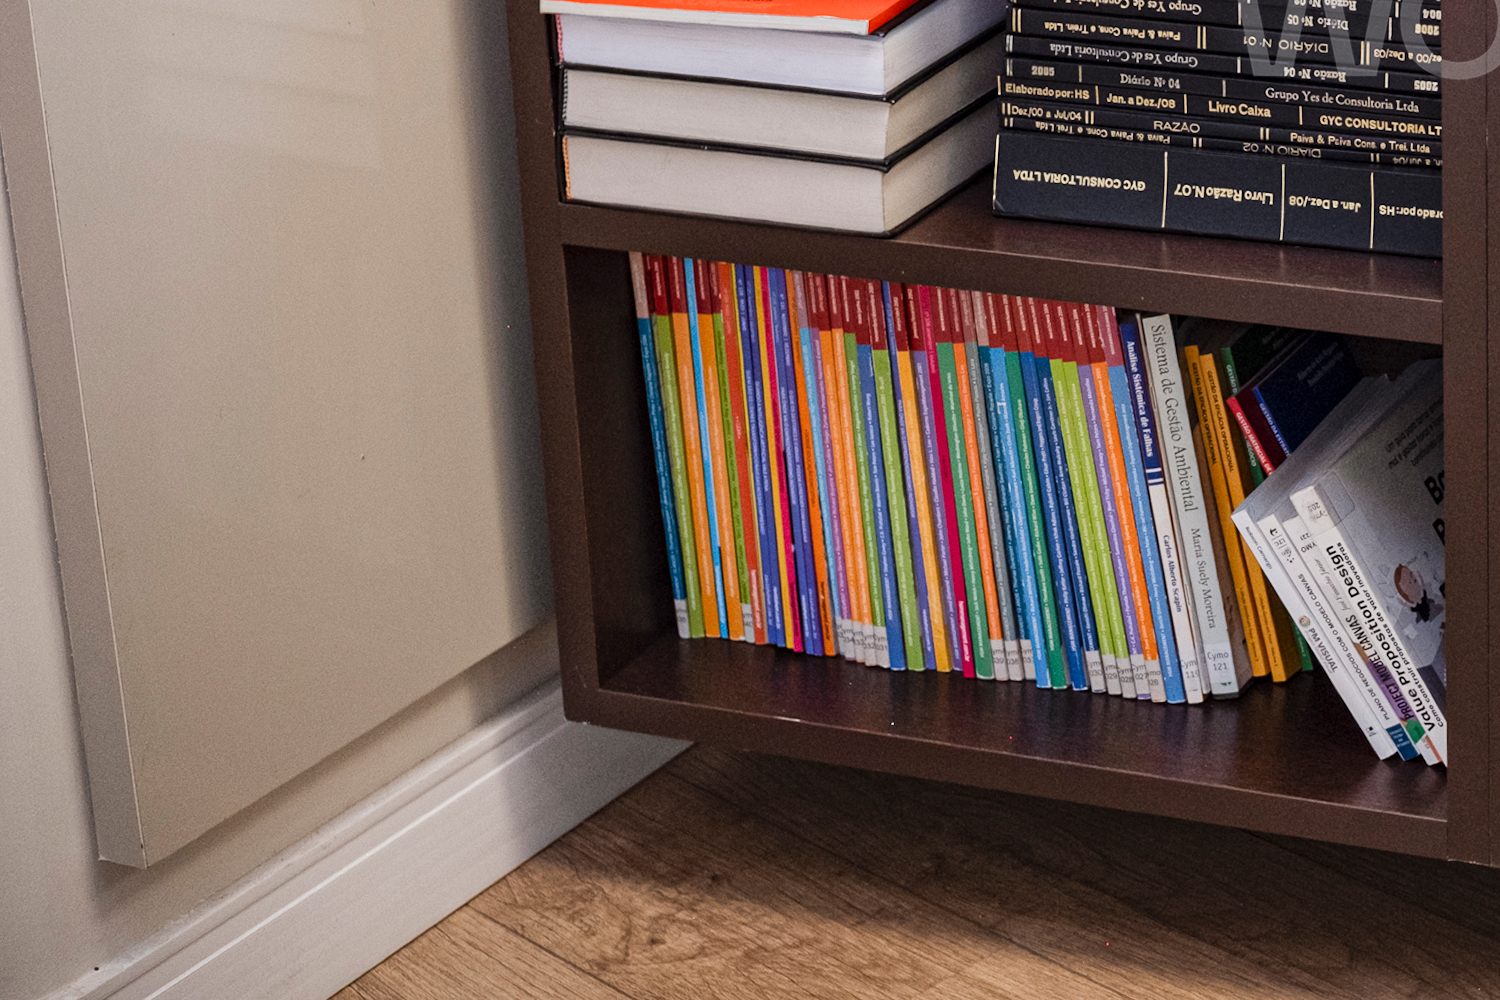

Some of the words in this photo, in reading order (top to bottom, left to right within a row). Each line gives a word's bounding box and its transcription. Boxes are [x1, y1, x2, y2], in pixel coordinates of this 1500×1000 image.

[1106, 93, 1126, 103] Jan.
[1135, 95, 1176, 110] Dez./08
[1208, 100, 1237, 114] Livro
[1237, 103, 1272, 117] Caixa
[1319, 115, 1342, 126] GYC
[1344, 117, 1426, 134] CONSULTORIA
[1012, 169, 1041, 181] LTDA
[1042, 172, 1121, 188] CONSULTORIA
[1122, 179, 1145, 190] GYC
[1173, 183, 1204, 197] N.07
[1205, 186, 1242, 201] Razão
[1243, 190, 1273, 204] Livro
[1288, 194, 1330, 209] Dez./08
[1331, 200, 1338, 208] a
[1339, 201, 1360, 212] Jan.
[1126, 340, 1138, 372] Análise
[1150, 324, 1172, 375] Sistema
[1132, 373, 1146, 415] Sistêmica
[1160, 377, 1176, 394] de
[1139, 416, 1149, 427] de
[1164, 397, 1184, 442] Gestão
[1142, 428, 1154, 457] Falhas
[1172, 444, 1198, 511] Ambiental
[1191, 527, 1204, 558] Maria
[1195, 560, 1210, 586] Suely
[1323, 543, 1361, 599] Design
[1202, 588, 1217, 629] Moreira
[1308, 627, 1321, 642] PM
[1315, 642, 1339, 672] VISUAL
[1353, 596, 1410, 688] Proposition
[1406, 686, 1436, 732] Value
